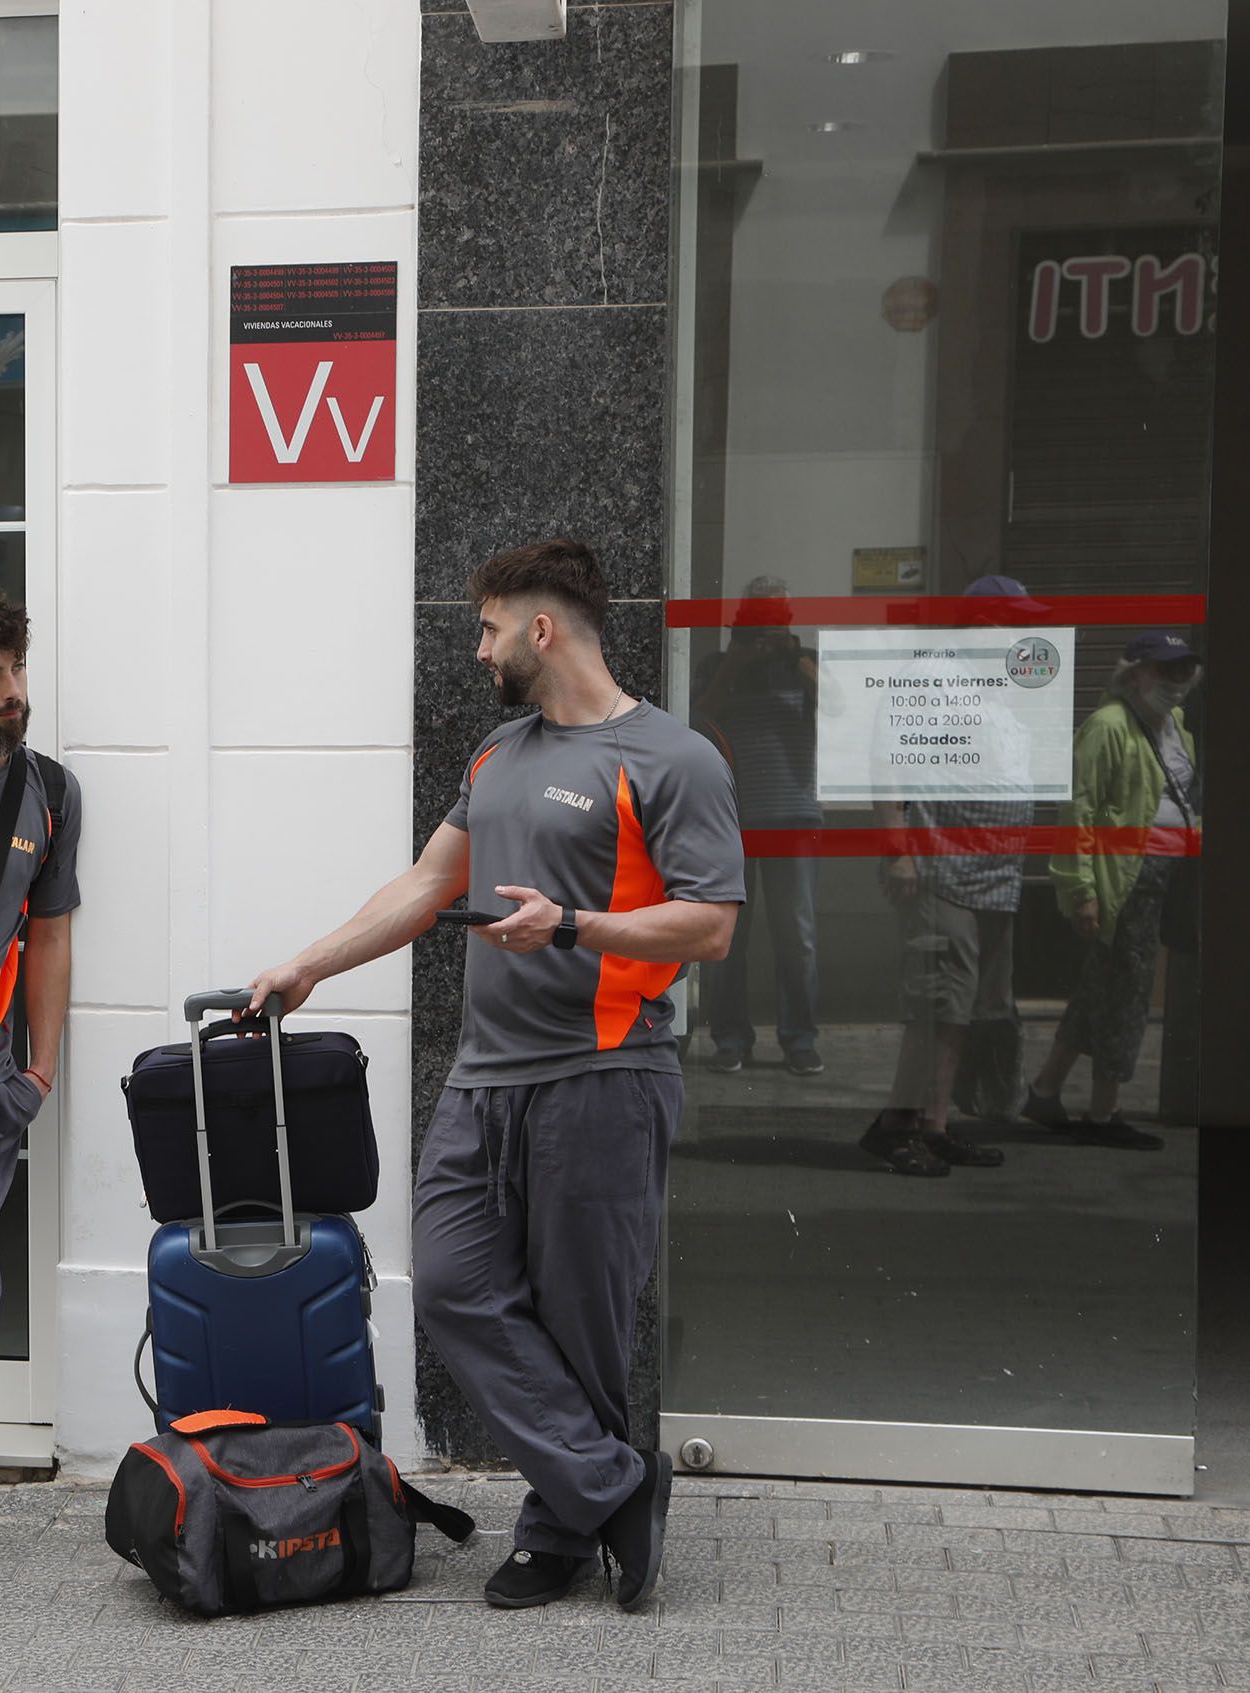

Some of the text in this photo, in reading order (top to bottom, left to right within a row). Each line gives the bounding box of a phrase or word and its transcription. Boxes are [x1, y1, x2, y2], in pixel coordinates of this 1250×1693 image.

[243, 320, 333, 330] VIVIENDAS VACACIONALES
[913, 649, 956, 659] Horario
[1010, 667, 1054, 676] OUTLET
[865, 675, 1008, 688] De lunes a viernes:
[891, 694, 981, 707] 10:00 a 14:00
[890, 714, 982, 727] 17:00 a 20:00
[900, 733, 971, 746] Sábados:
[890, 752, 981, 765] 10:00 a 14:00
[544, 786, 594, 812] CRISTALAN
